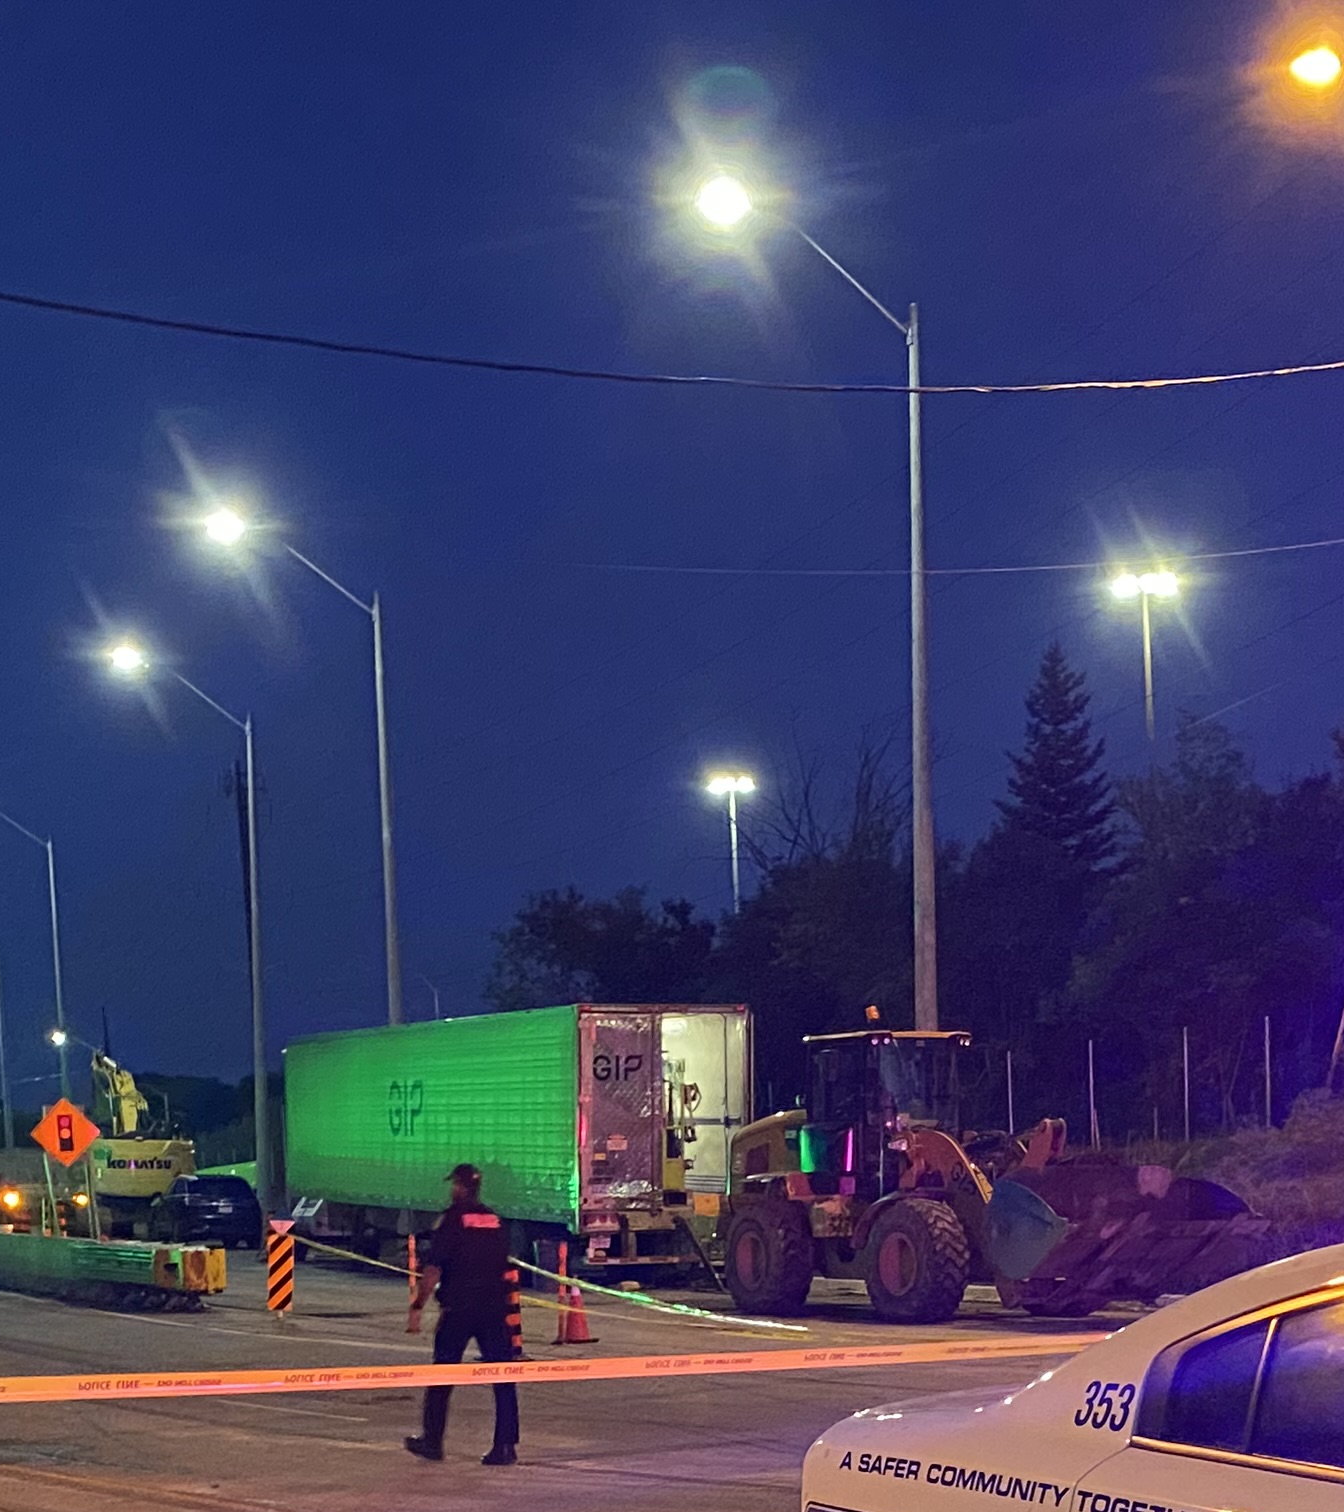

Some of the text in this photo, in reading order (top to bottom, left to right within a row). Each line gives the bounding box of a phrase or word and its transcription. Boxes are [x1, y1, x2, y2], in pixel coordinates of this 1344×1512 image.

[592, 1055, 643, 1081] GIP
[388, 1080, 424, 1137] GIP
[1074, 1380, 1136, 1432] 353
[839, 1451, 854, 1471] A
[858, 1453, 921, 1481] SAFER
[926, 1463, 1069, 1508] COMMUNITY
